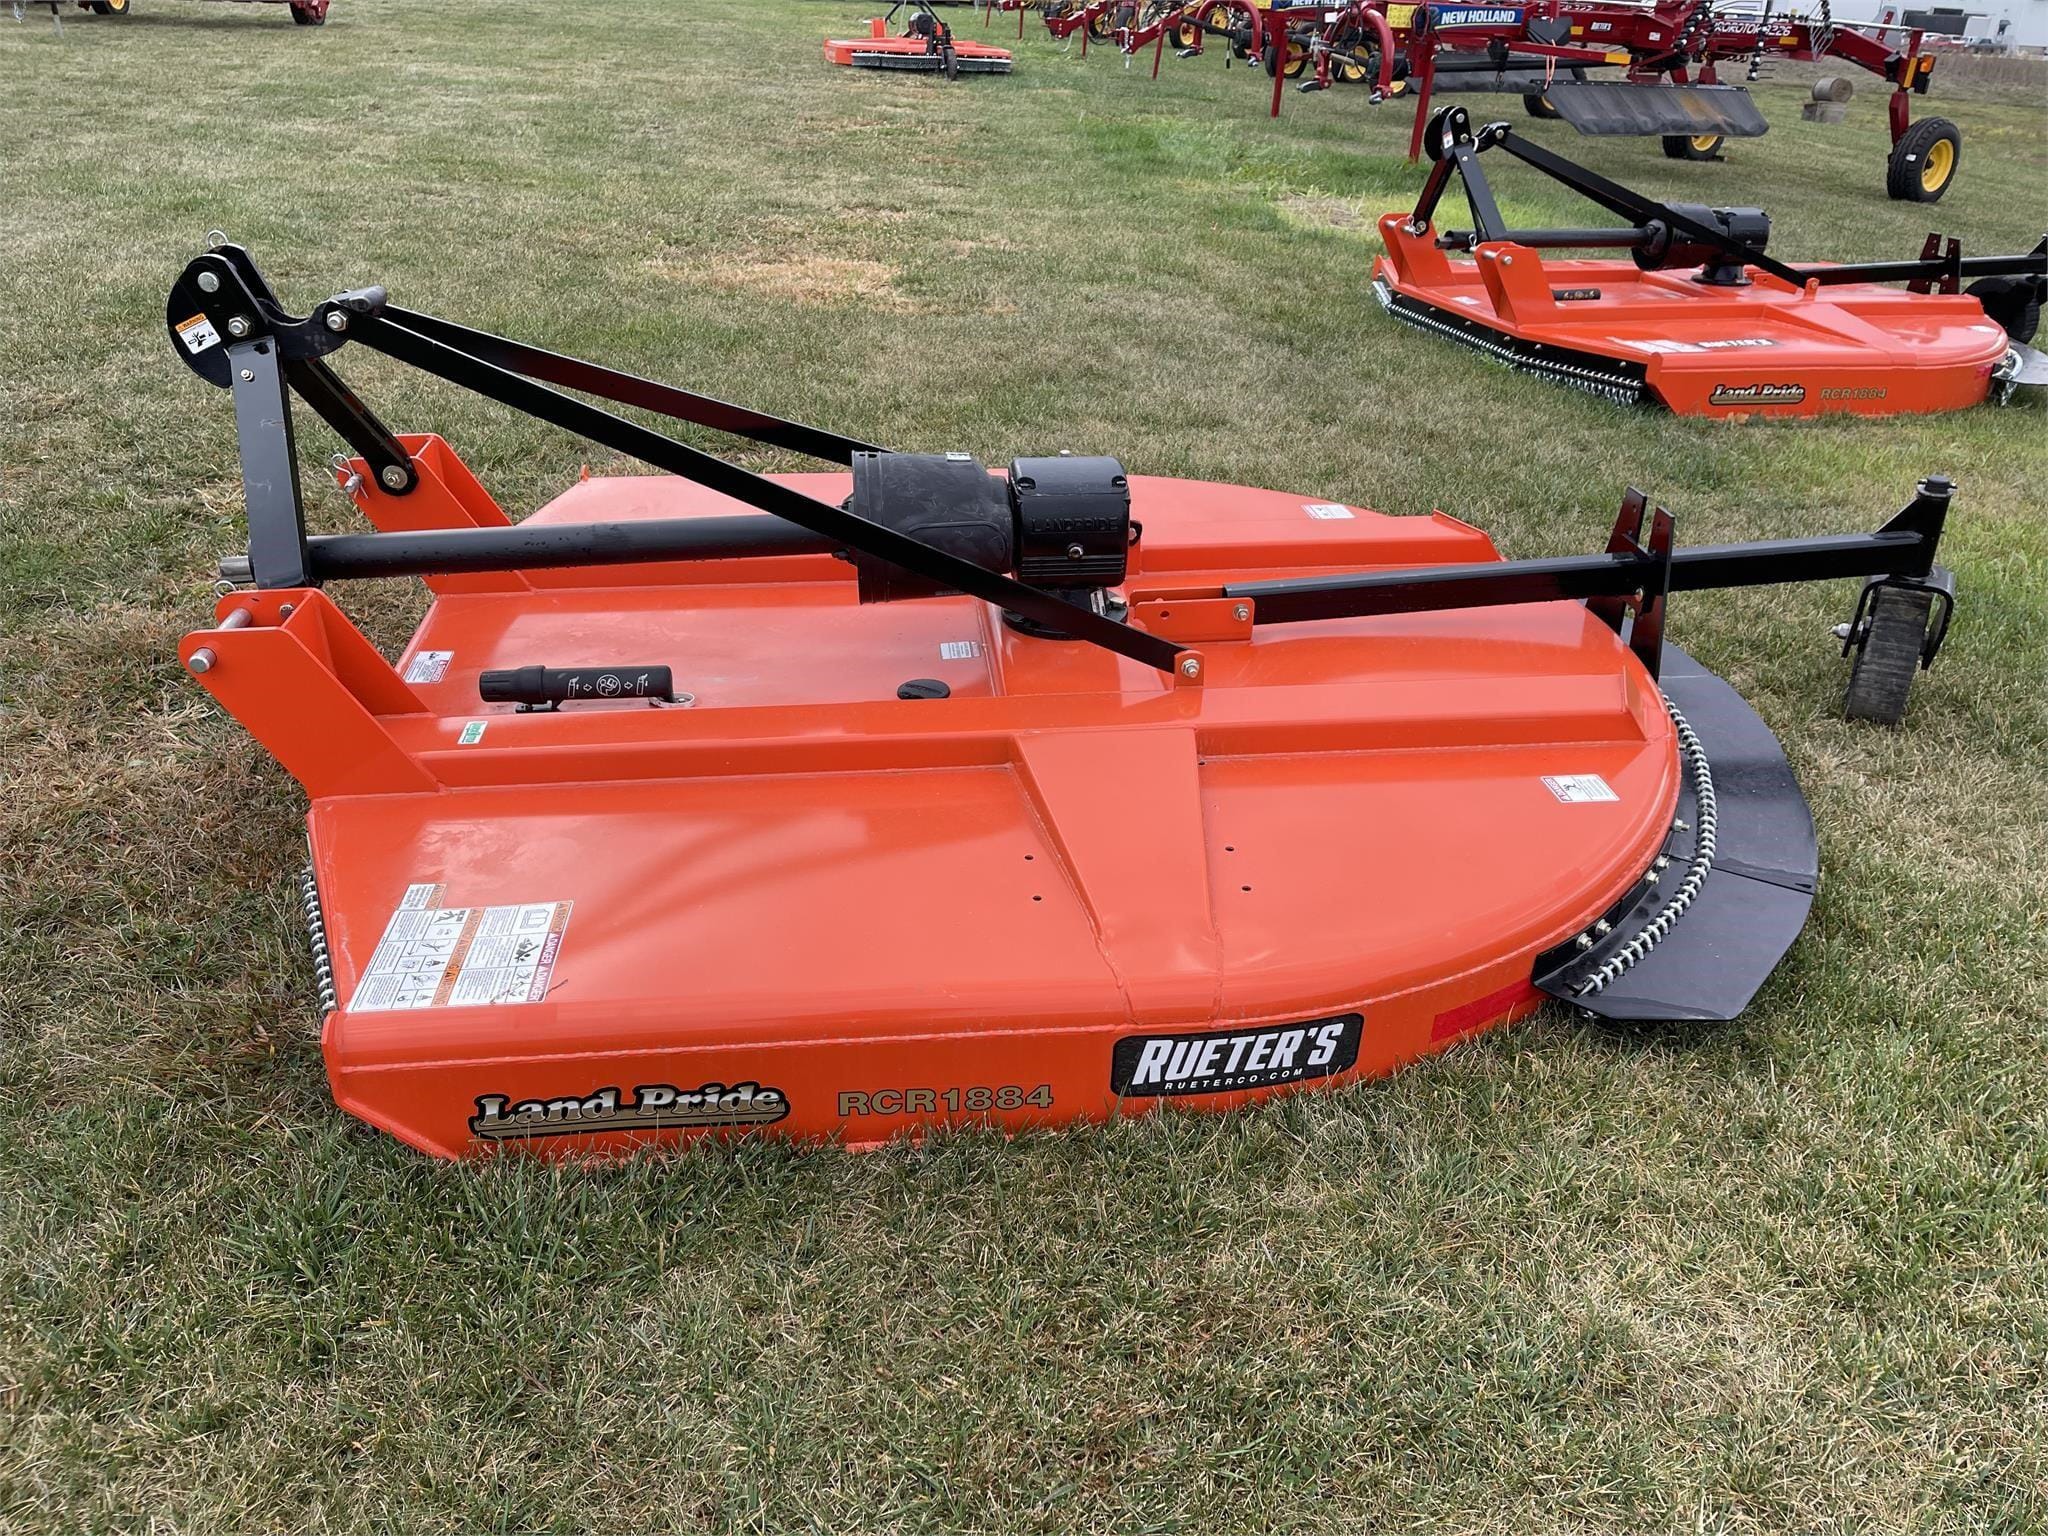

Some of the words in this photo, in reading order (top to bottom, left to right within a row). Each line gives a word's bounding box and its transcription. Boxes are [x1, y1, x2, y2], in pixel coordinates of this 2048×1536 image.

[1441, 11, 1465, 25] NEW
[1467, 10, 1516, 23] HOLLAND
[1715, 384, 1758, 400] Land
[1761, 383, 1805, 398] Pride
[1820, 387, 1888, 401] RCR1884
[540, 937, 559, 965] DANGER
[527, 970, 548, 1001] DANGER
[1131, 1022, 1345, 1086] RUETER'S
[1164, 1067, 1303, 1090] RUETERCO.COM
[480, 1090, 617, 1127] Land
[636, 1084, 781, 1116] Pride
[837, 1084, 1054, 1117] RCR1884
